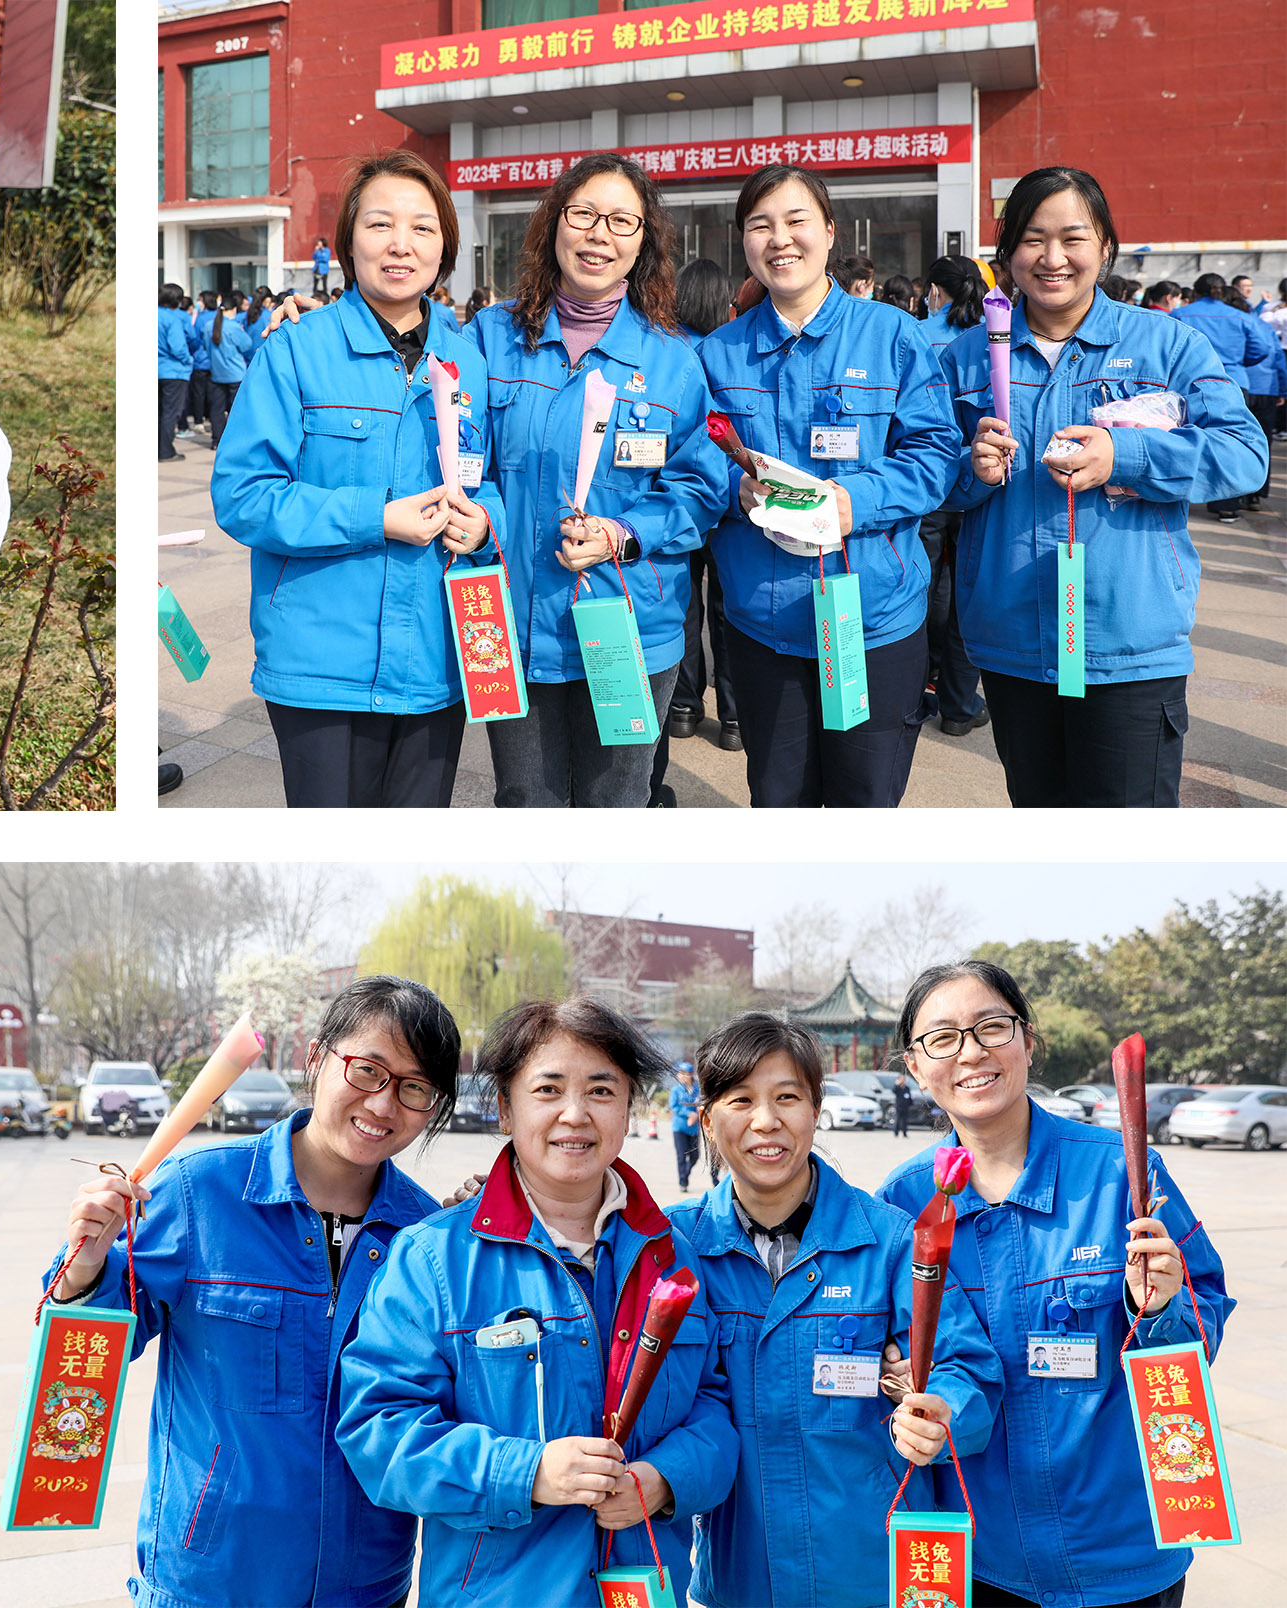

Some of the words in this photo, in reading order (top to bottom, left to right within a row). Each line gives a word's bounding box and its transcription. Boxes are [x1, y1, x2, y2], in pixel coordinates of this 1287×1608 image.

[215, 36, 249, 53] 2007
[394, 43, 480, 76] 凝心聚力
[498, 28, 594, 64] 勇毅前行
[1107, 358, 1132, 368] JIER
[844, 368, 867, 379] JIER
[461, 584, 493, 601] 钱兔
[463, 600, 495, 617] 无量
[1071, 1245, 1101, 1261] JIER
[822, 1286, 852, 1298] JIER
[63, 1330, 109, 1355] 钱兔
[58, 1355, 106, 1379] 无量
[1145, 1364, 1189, 1387] 钱兔
[1148, 1385, 1192, 1407] 无量
[1165, 1495, 1215, 1511] 2023
[909, 1540, 952, 1563] 钱兔
[909, 1562, 952, 1584] 无量
